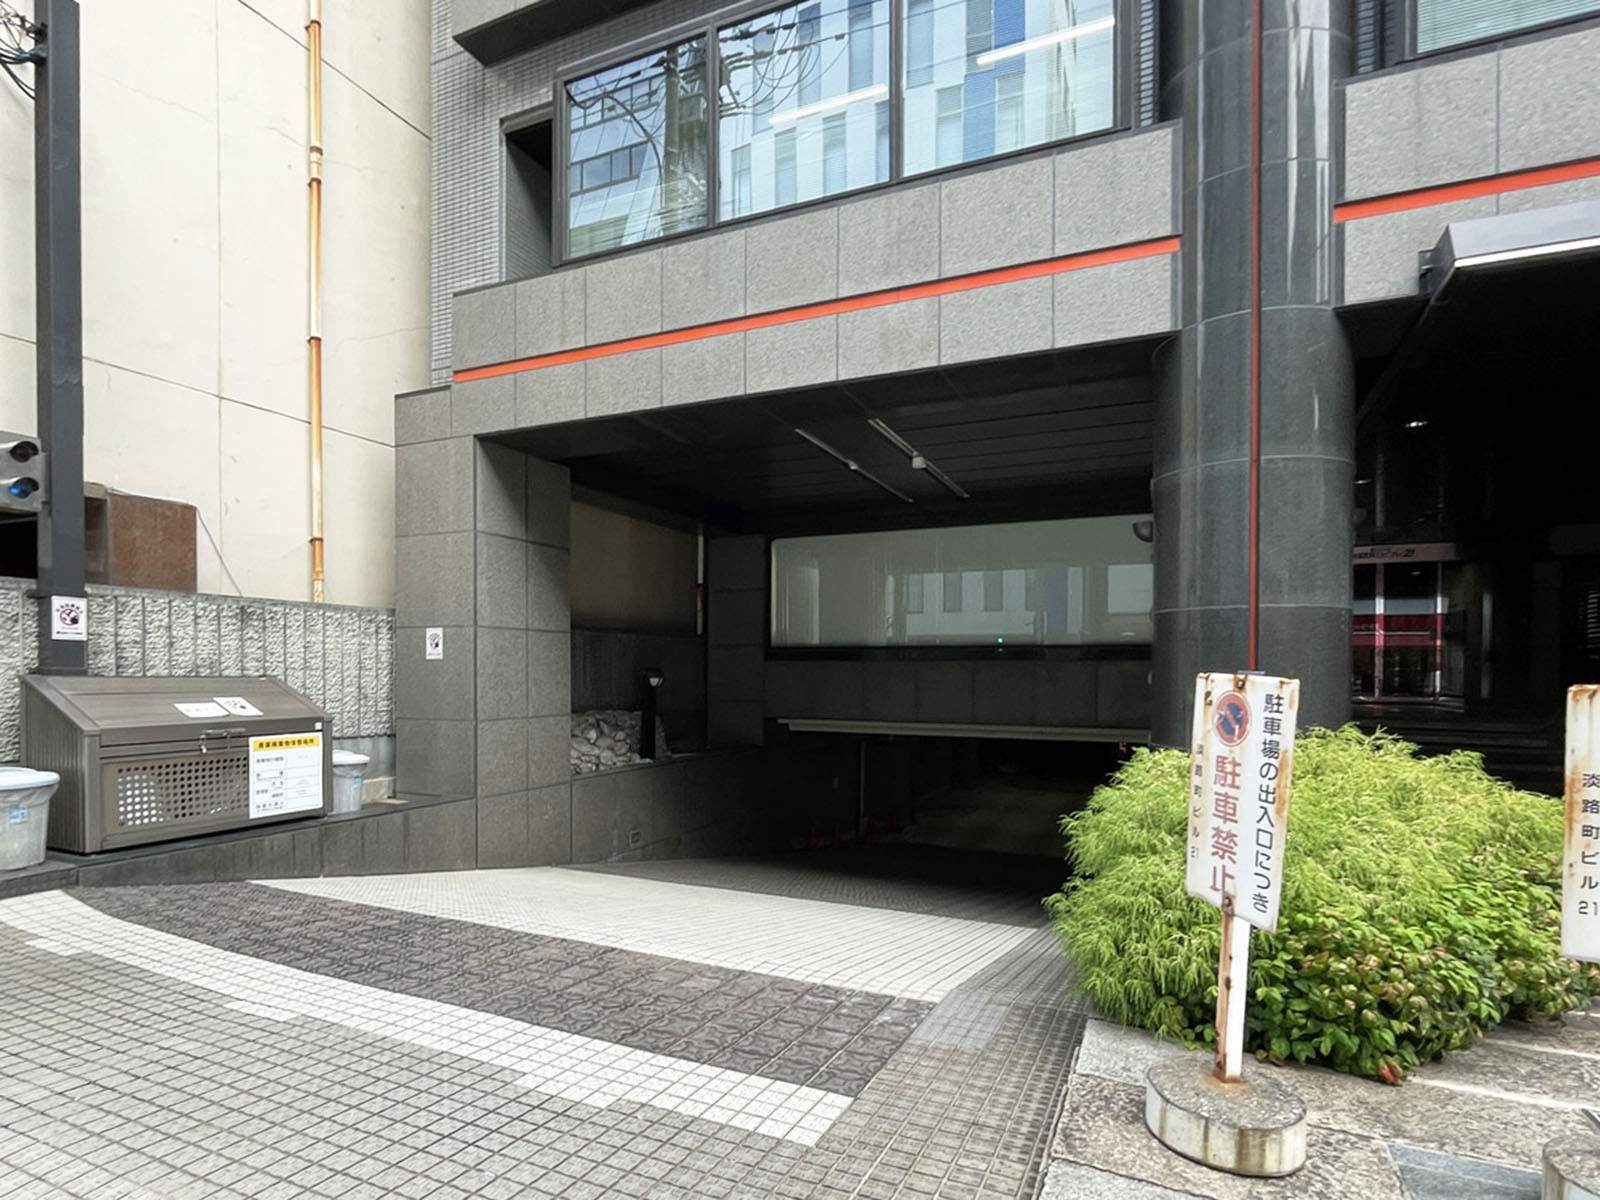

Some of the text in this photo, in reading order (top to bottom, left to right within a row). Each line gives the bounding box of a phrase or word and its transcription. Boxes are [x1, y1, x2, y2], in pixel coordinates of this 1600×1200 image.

[1208, 755, 1242, 898] 駐車禁止
[1252, 693, 1285, 914] 駐車場の出入口につき
